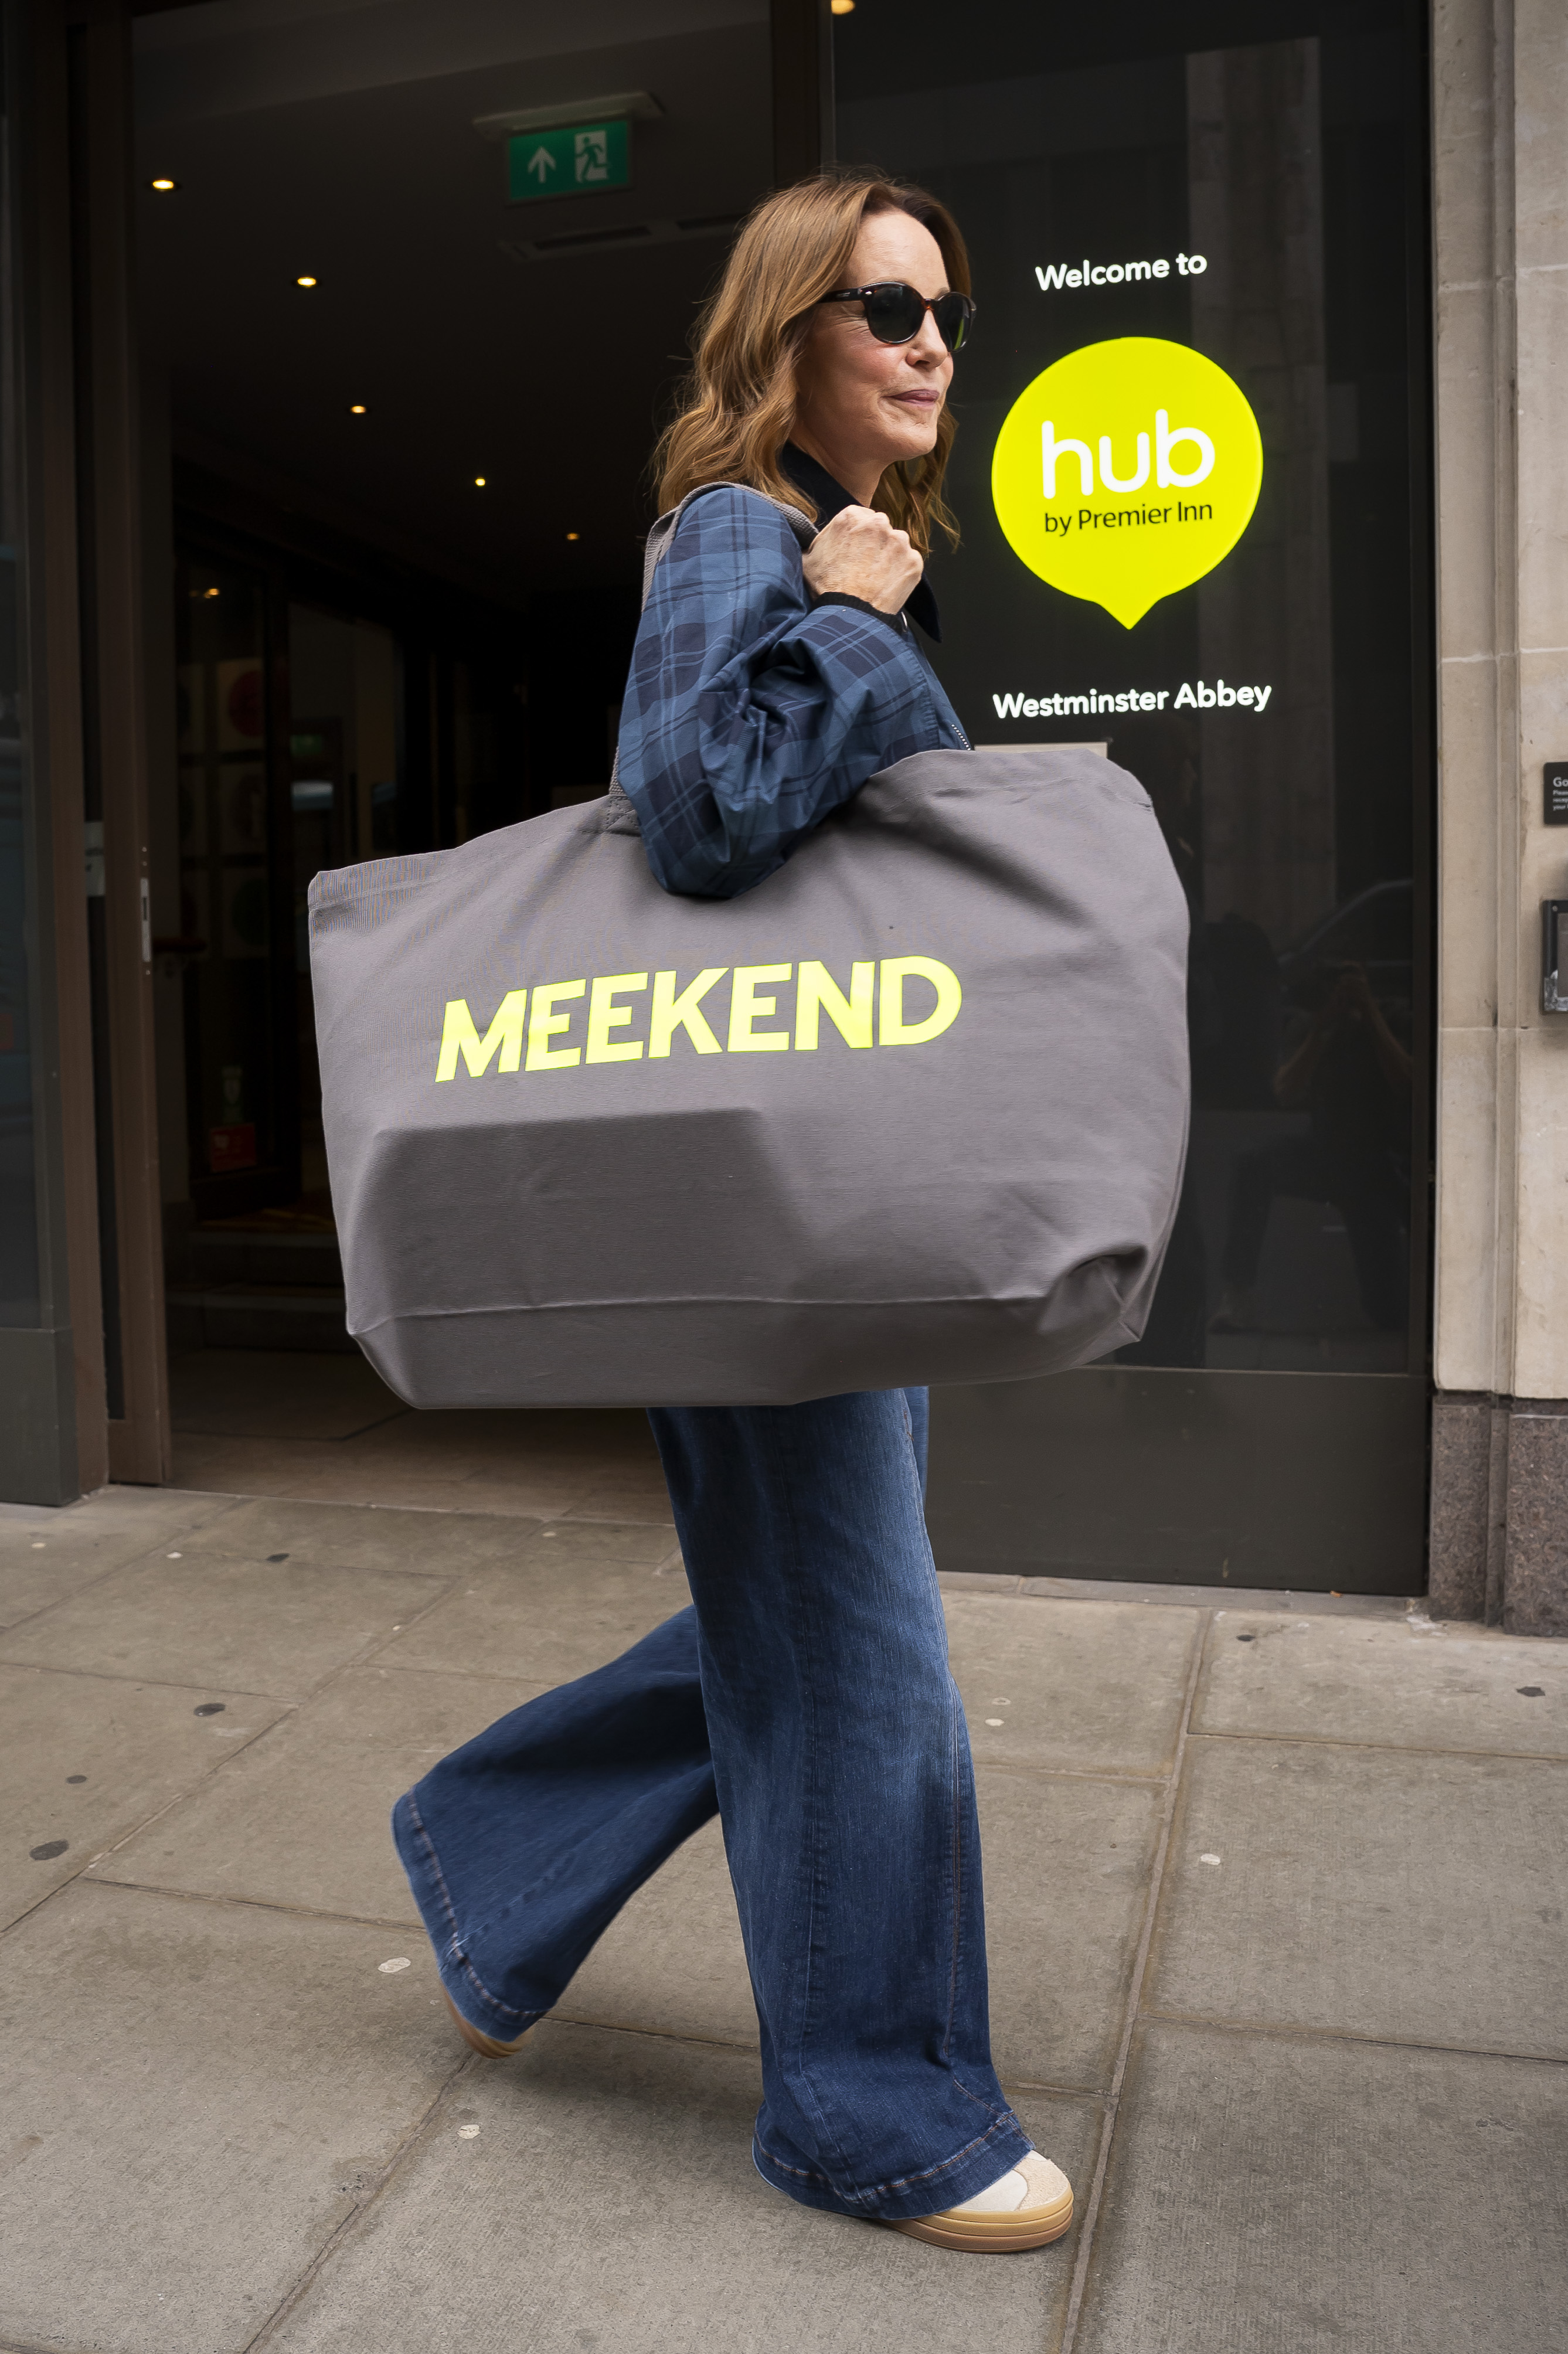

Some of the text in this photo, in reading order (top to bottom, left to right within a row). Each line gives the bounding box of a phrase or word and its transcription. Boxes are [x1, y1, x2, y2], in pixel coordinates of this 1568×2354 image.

[1035, 253, 1208, 291] Welcome to
[1041, 409, 1215, 499] hub
[1045, 501, 1212, 537] by Premier Inn
[992, 679, 1272, 719] Westminster Abbey
[435, 955, 962, 1083] MEEKEND
